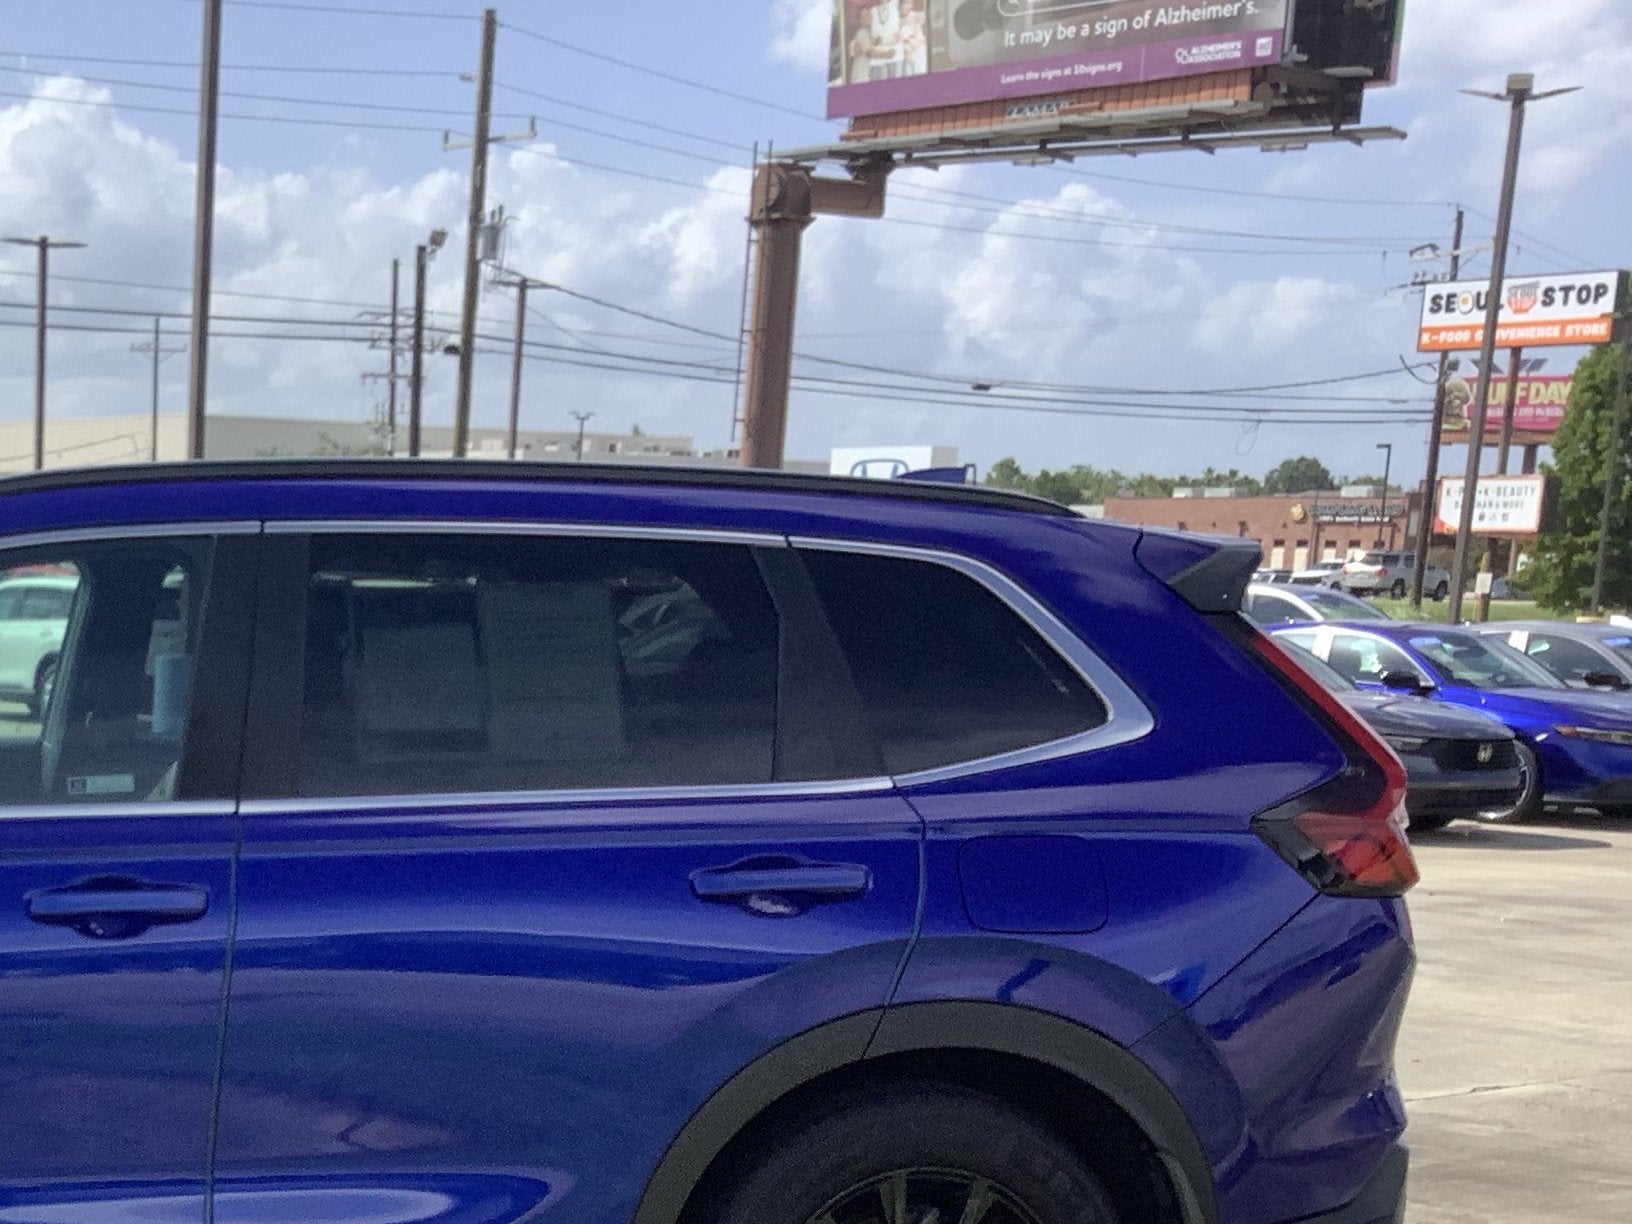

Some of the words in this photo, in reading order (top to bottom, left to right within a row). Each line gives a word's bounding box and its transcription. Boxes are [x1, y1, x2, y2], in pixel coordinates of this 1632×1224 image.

[1003, 31, 1016, 48] It
[1020, 27, 1053, 47] may
[1057, 20, 1077, 40] be
[1080, 23, 1091, 37] a
[1094, 15, 1128, 39] sign
[1132, 10, 1152, 29] of
[1154, 0, 1260, 27] Alzheimer's.
[1000, 71, 1024, 84] Learn
[1025, 69, 1039, 81] the
[1040, 66, 1062, 81] signs
[1063, 65, 1072, 76] at
[1074, 61, 1123, 76] 10signs.org
[1429, 290, 1505, 315] SEOU
[1541, 282, 1609, 308] STOP
[1420, 328, 1472, 344] K-FOOD
[1474, 324, 1561, 342] CVENIENCE
[1565, 321, 1608, 337] STORE
[1528, 380, 1572, 405] DAY
